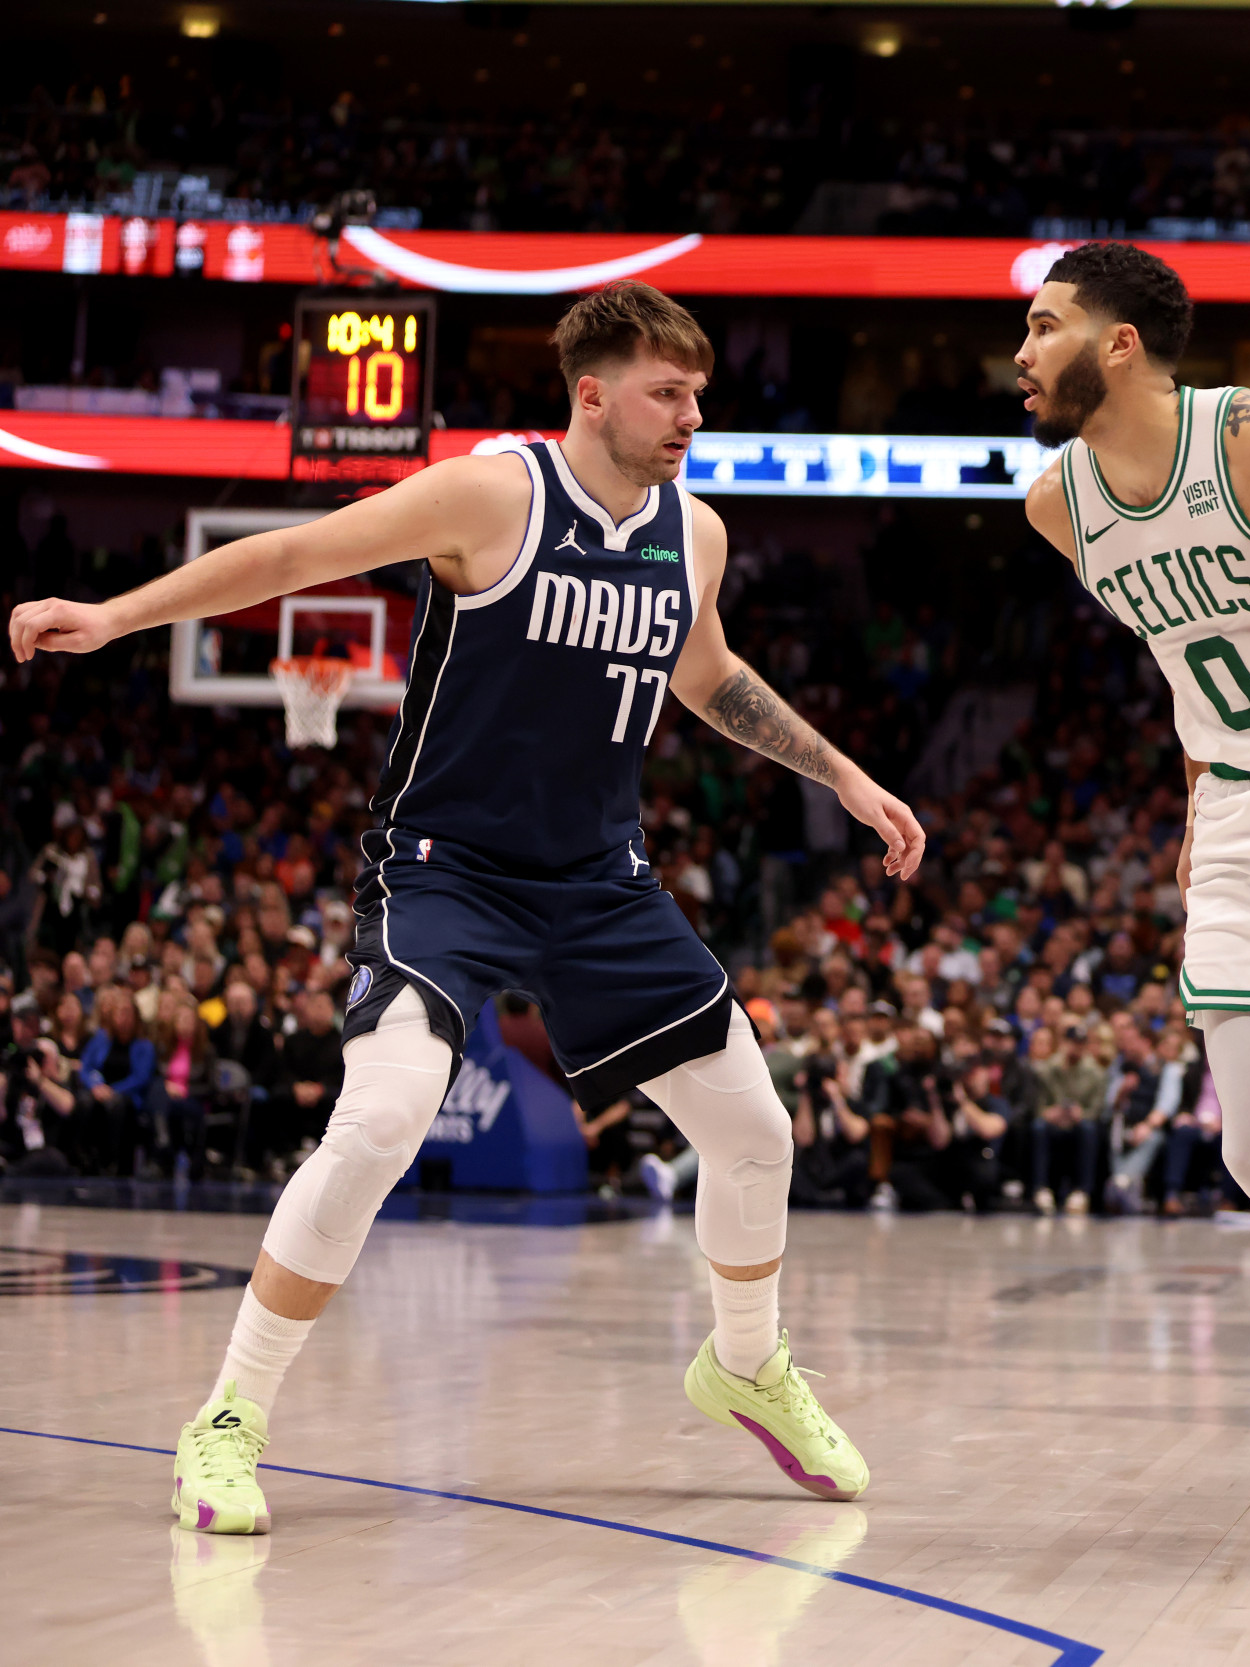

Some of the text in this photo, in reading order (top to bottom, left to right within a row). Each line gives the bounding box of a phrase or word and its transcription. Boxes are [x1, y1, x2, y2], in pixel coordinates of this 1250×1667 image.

[327, 312, 417, 355] 10:41
[346, 351, 404, 421] 10
[335, 427, 421, 450] TISSOT
[1182, 479, 1217, 504] VISTA
[1187, 496, 1220, 519] PRINT
[640, 544, 680, 563] chime
[526, 571, 681, 658] MAVS
[605, 663, 669, 747] 77
